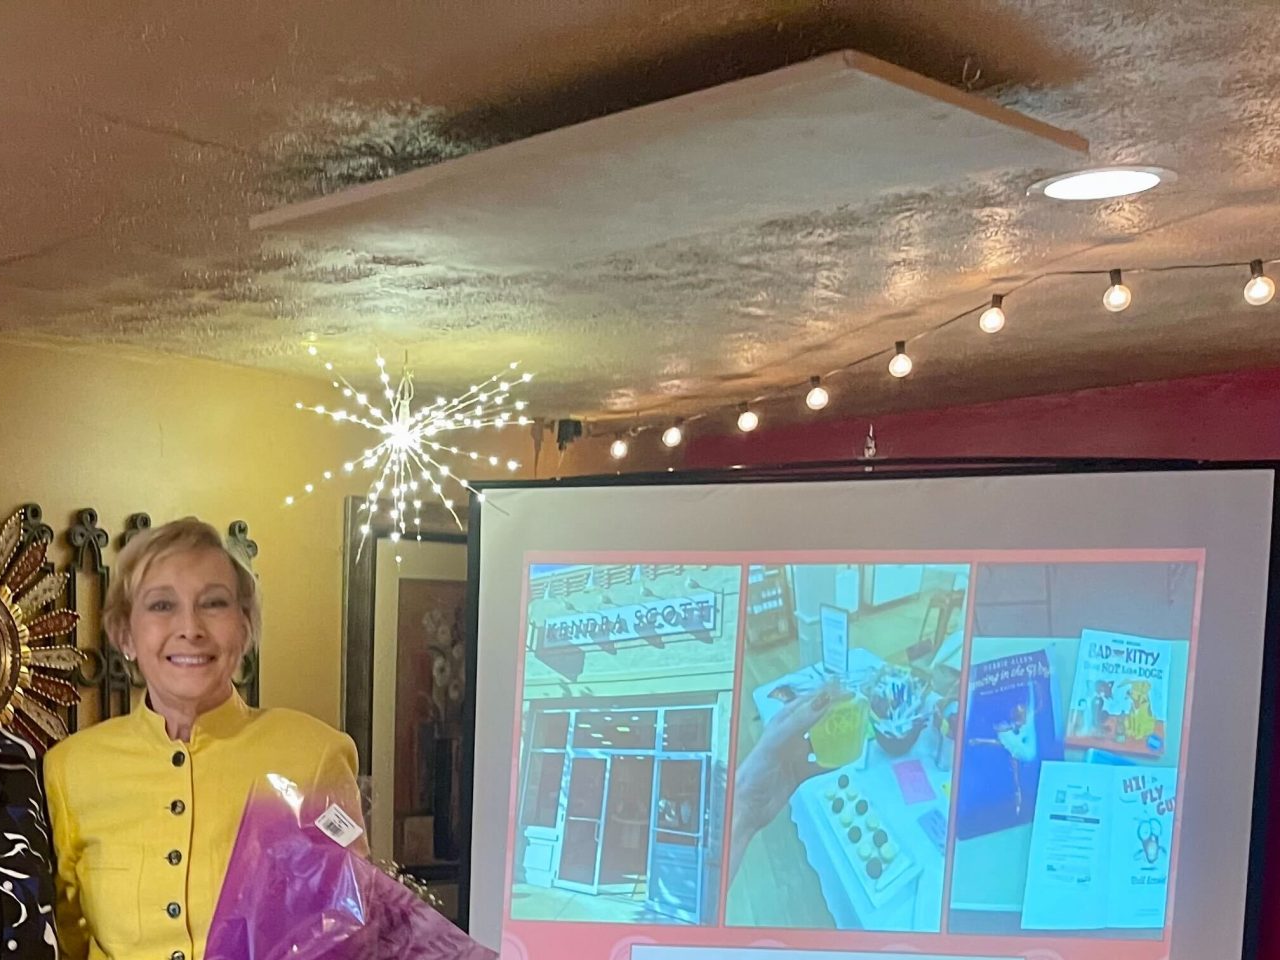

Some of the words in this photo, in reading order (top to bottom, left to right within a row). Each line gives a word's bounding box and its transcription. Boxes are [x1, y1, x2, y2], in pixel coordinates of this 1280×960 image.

[634, 600, 712, 632] SCOTT
[1126, 647, 1160, 666] KITTY
[1156, 796, 1175, 816] GU
